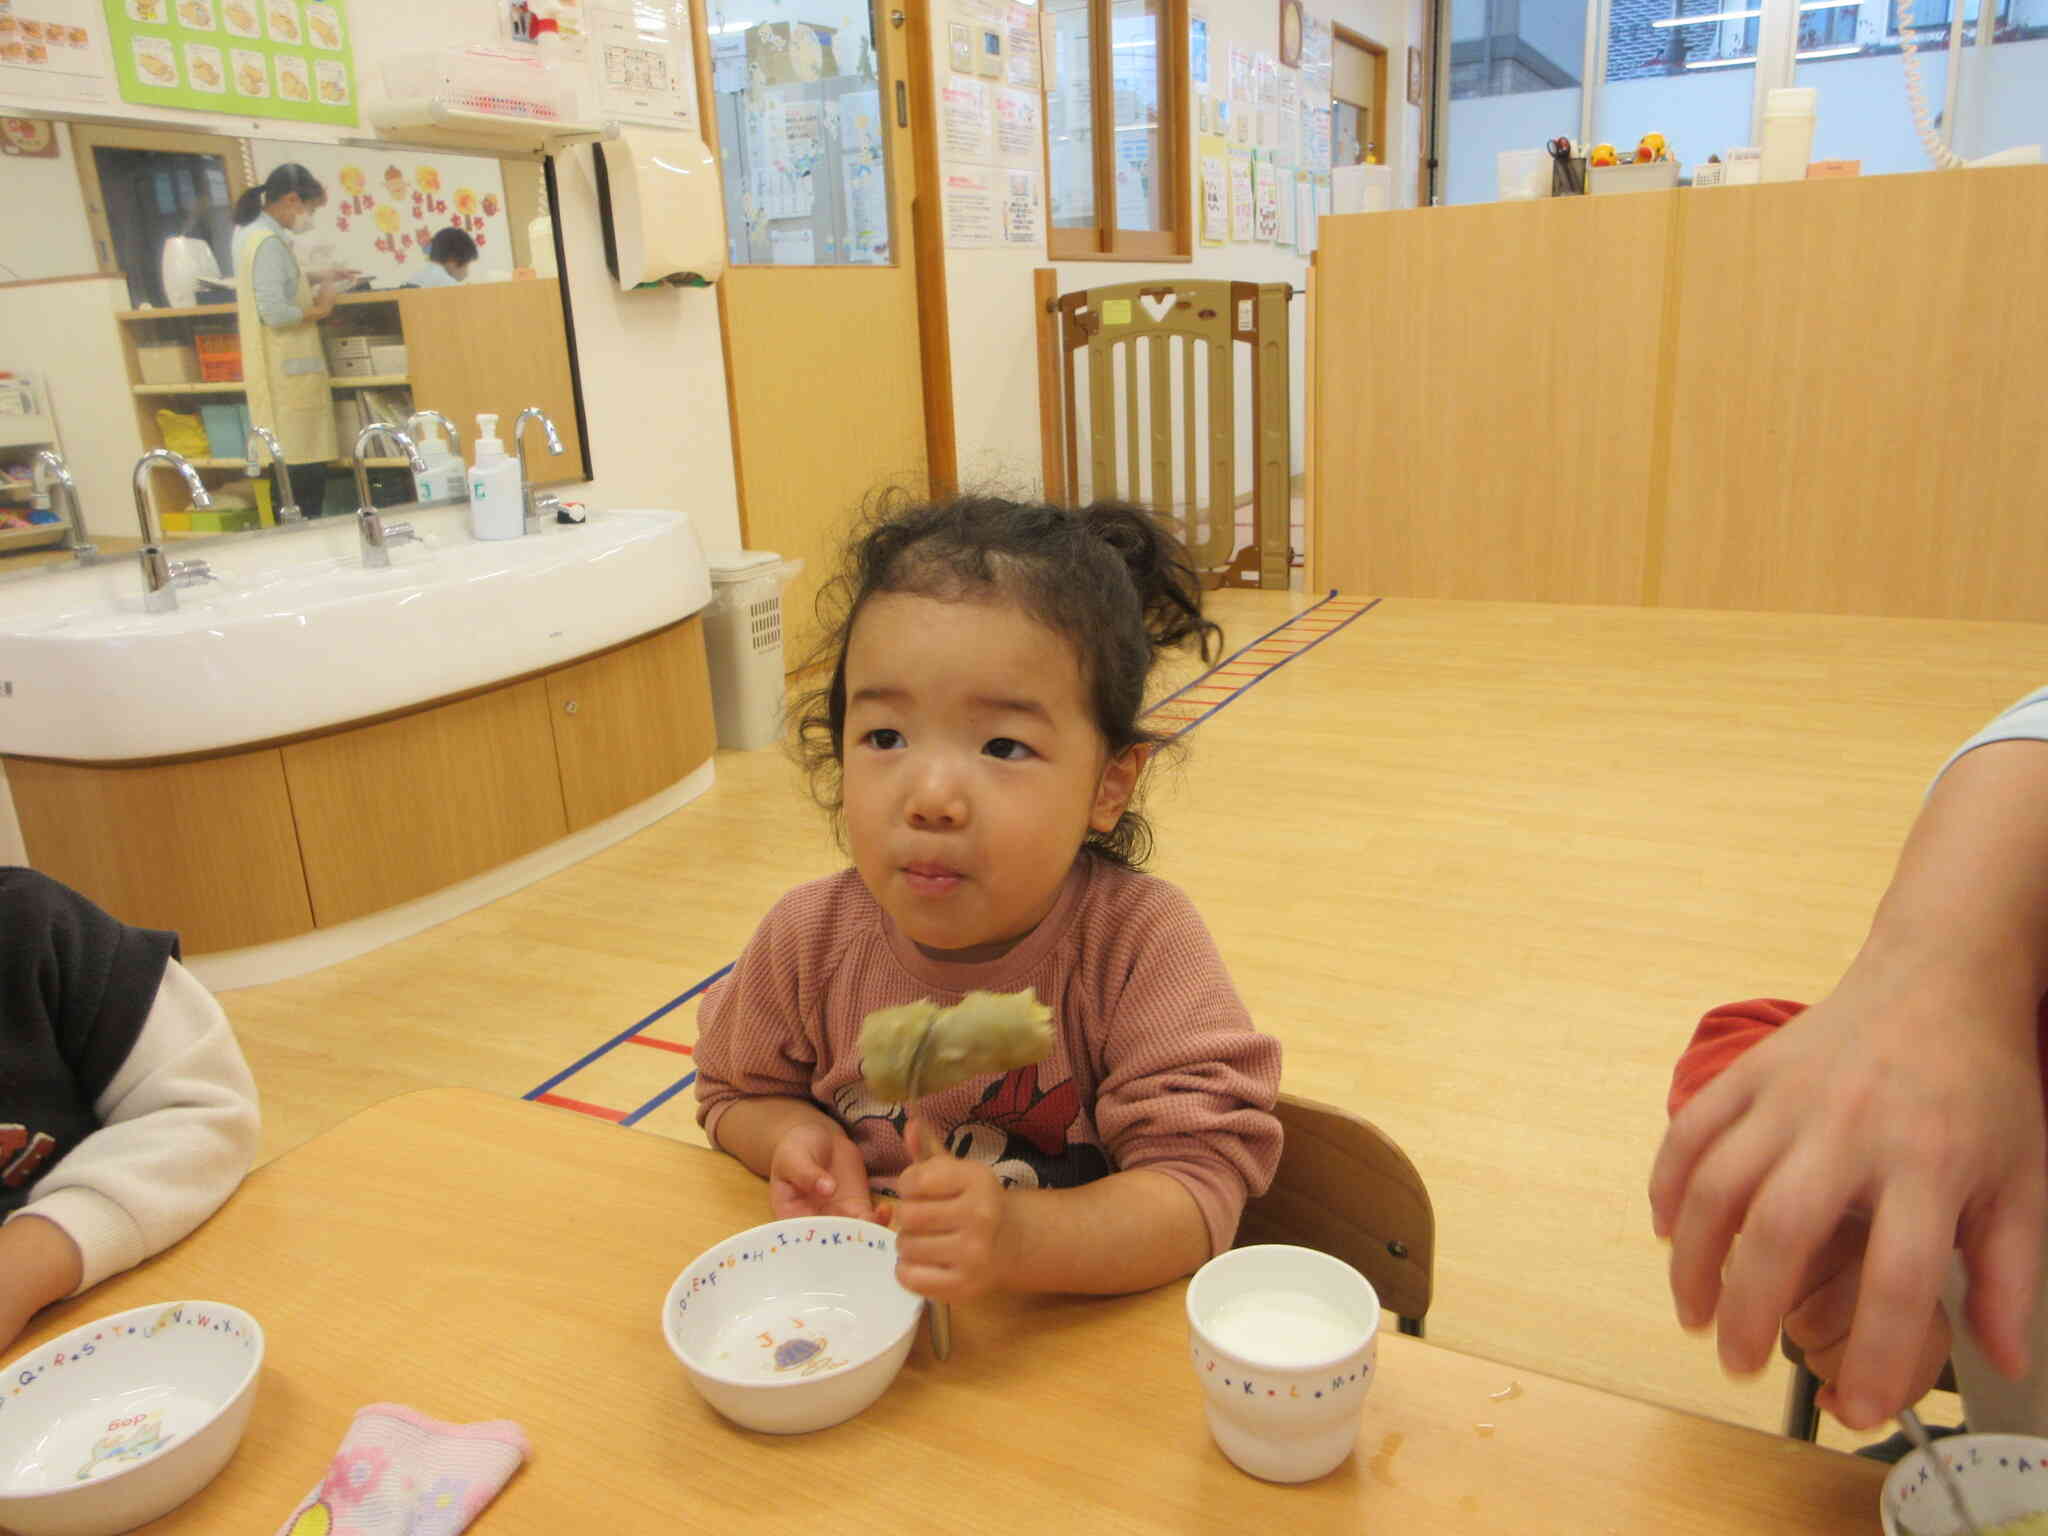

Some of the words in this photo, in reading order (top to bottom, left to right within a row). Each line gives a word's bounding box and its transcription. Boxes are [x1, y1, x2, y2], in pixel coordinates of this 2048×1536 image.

[18, 1370, 38, 1386] Q
[53, 1352, 65, 1367] R
[81, 1343, 96, 1356] S
